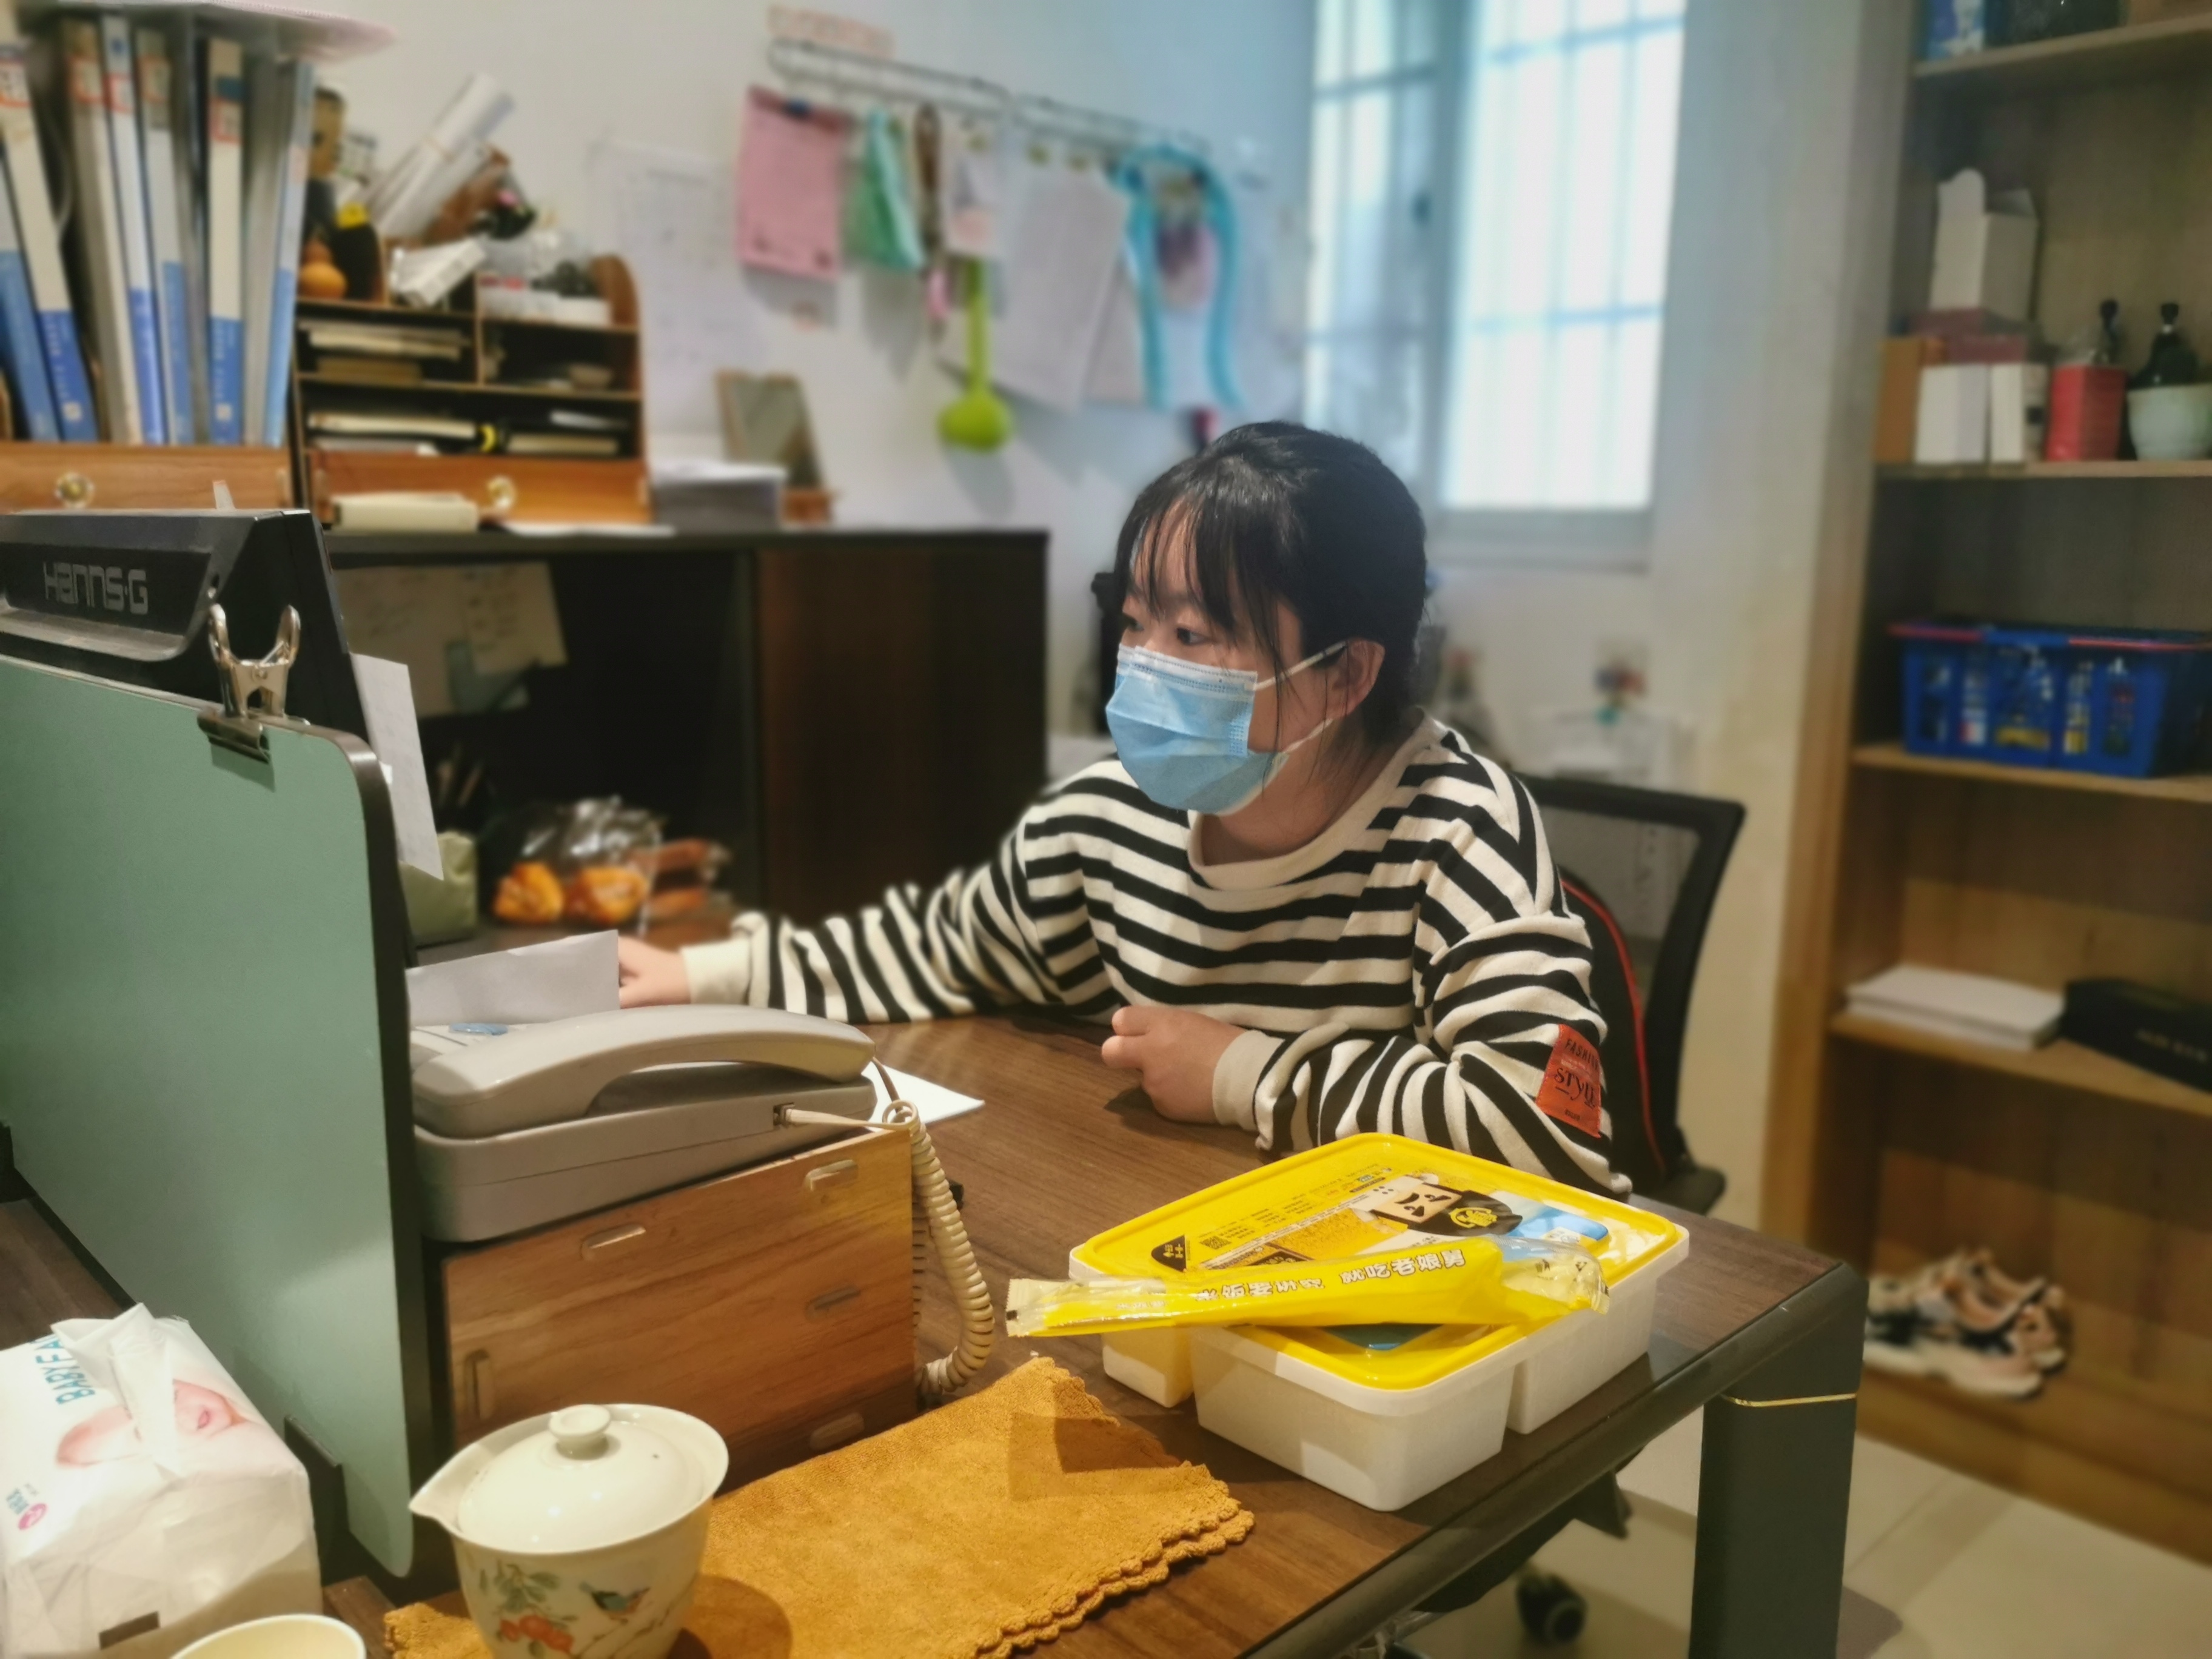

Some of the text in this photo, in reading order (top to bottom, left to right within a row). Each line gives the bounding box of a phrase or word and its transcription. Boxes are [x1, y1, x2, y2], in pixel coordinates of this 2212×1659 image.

[1339, 1249, 1466, 1284] 就吃老娘舅
